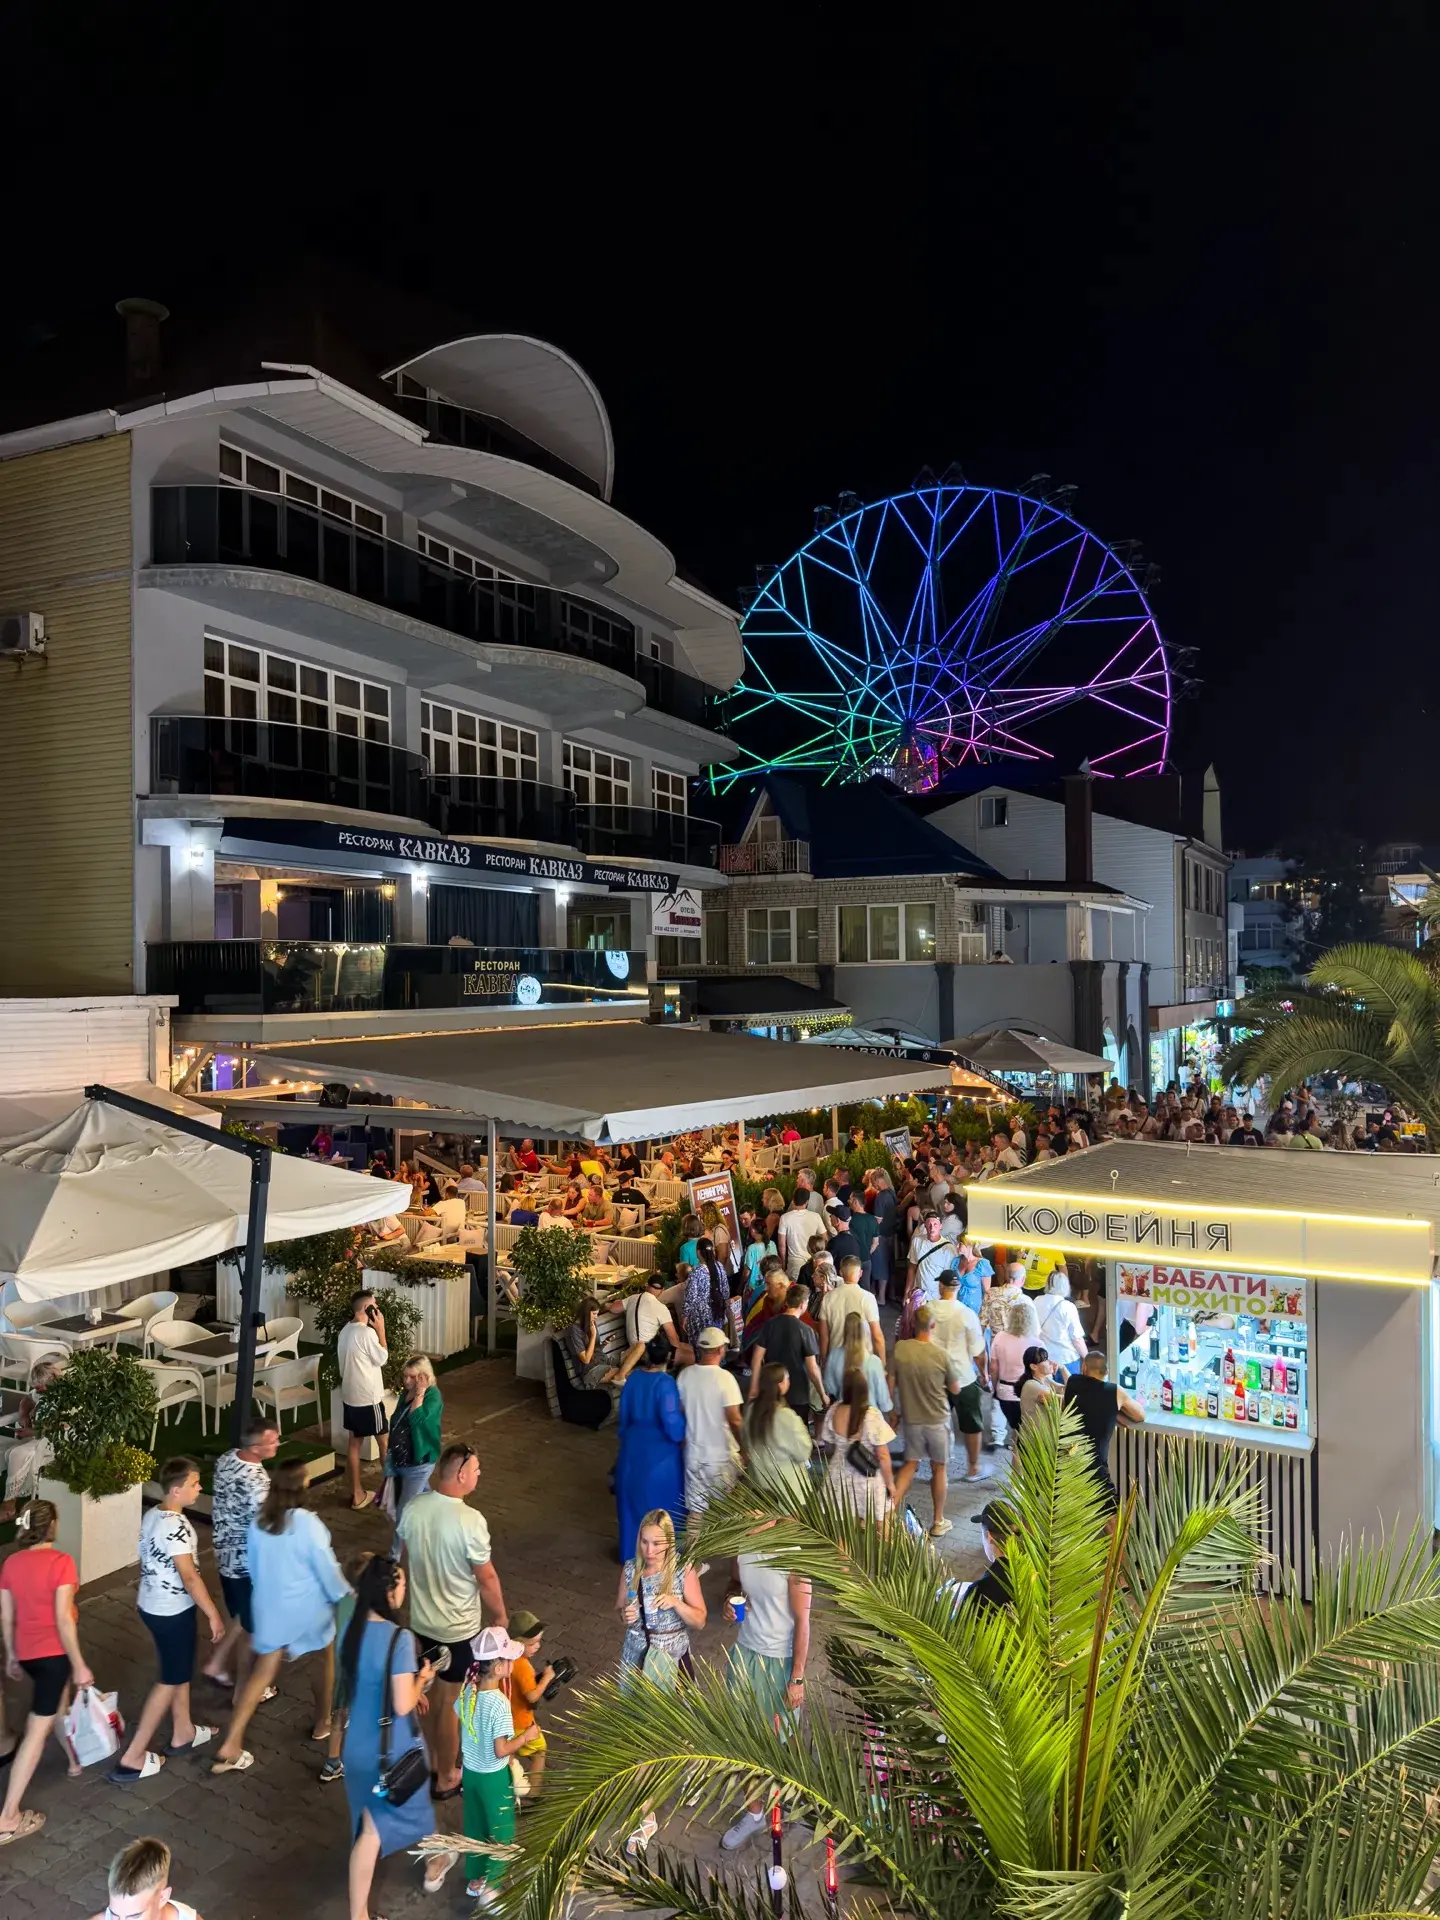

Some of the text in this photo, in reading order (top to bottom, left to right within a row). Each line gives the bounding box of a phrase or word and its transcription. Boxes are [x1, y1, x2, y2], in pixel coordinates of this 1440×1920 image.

[338, 832, 670, 890] РЕСТОРАН КАВКАЗ РЕСТОРАН КАВКАЗ РЕСТОРАН КАВКАЗ
[474, 961, 521, 971] РЕСТОРАН
[463, 973, 531, 995] КАВКА
[1003, 1203, 1233, 1252] КОФЕЙНЯ
[1152, 1265, 1267, 1297] БАБЛТИ
[1152, 1286, 1267, 1316] МОХИТО
